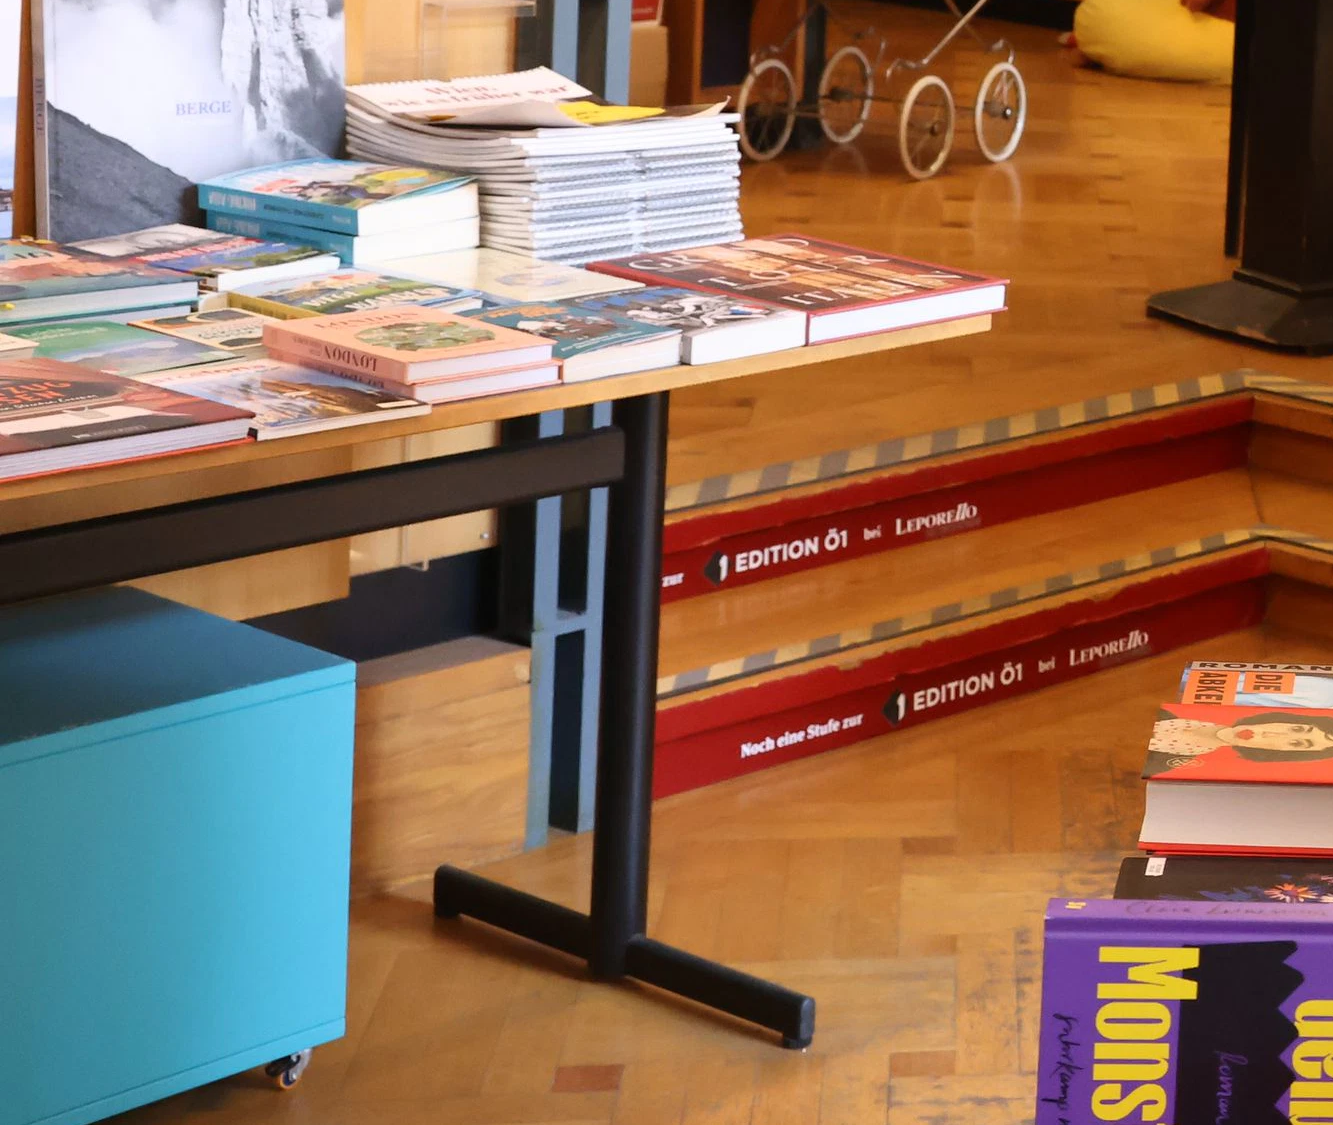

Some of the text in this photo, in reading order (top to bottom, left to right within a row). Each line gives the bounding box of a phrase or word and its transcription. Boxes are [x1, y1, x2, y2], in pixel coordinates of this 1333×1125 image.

[176, 100, 232, 116] BERGE
[321, 345, 378, 373] LONDON
[662, 525, 882, 588] zur EDITION Ö1 bei
[1199, 662, 1333, 672] ROMAN
[1253, 674, 1283, 692] DIE
[740, 656, 1055, 759] Noch eine Stufe zur EDITION Ö1 bei
[1092, 946, 1200, 1125] Mons
